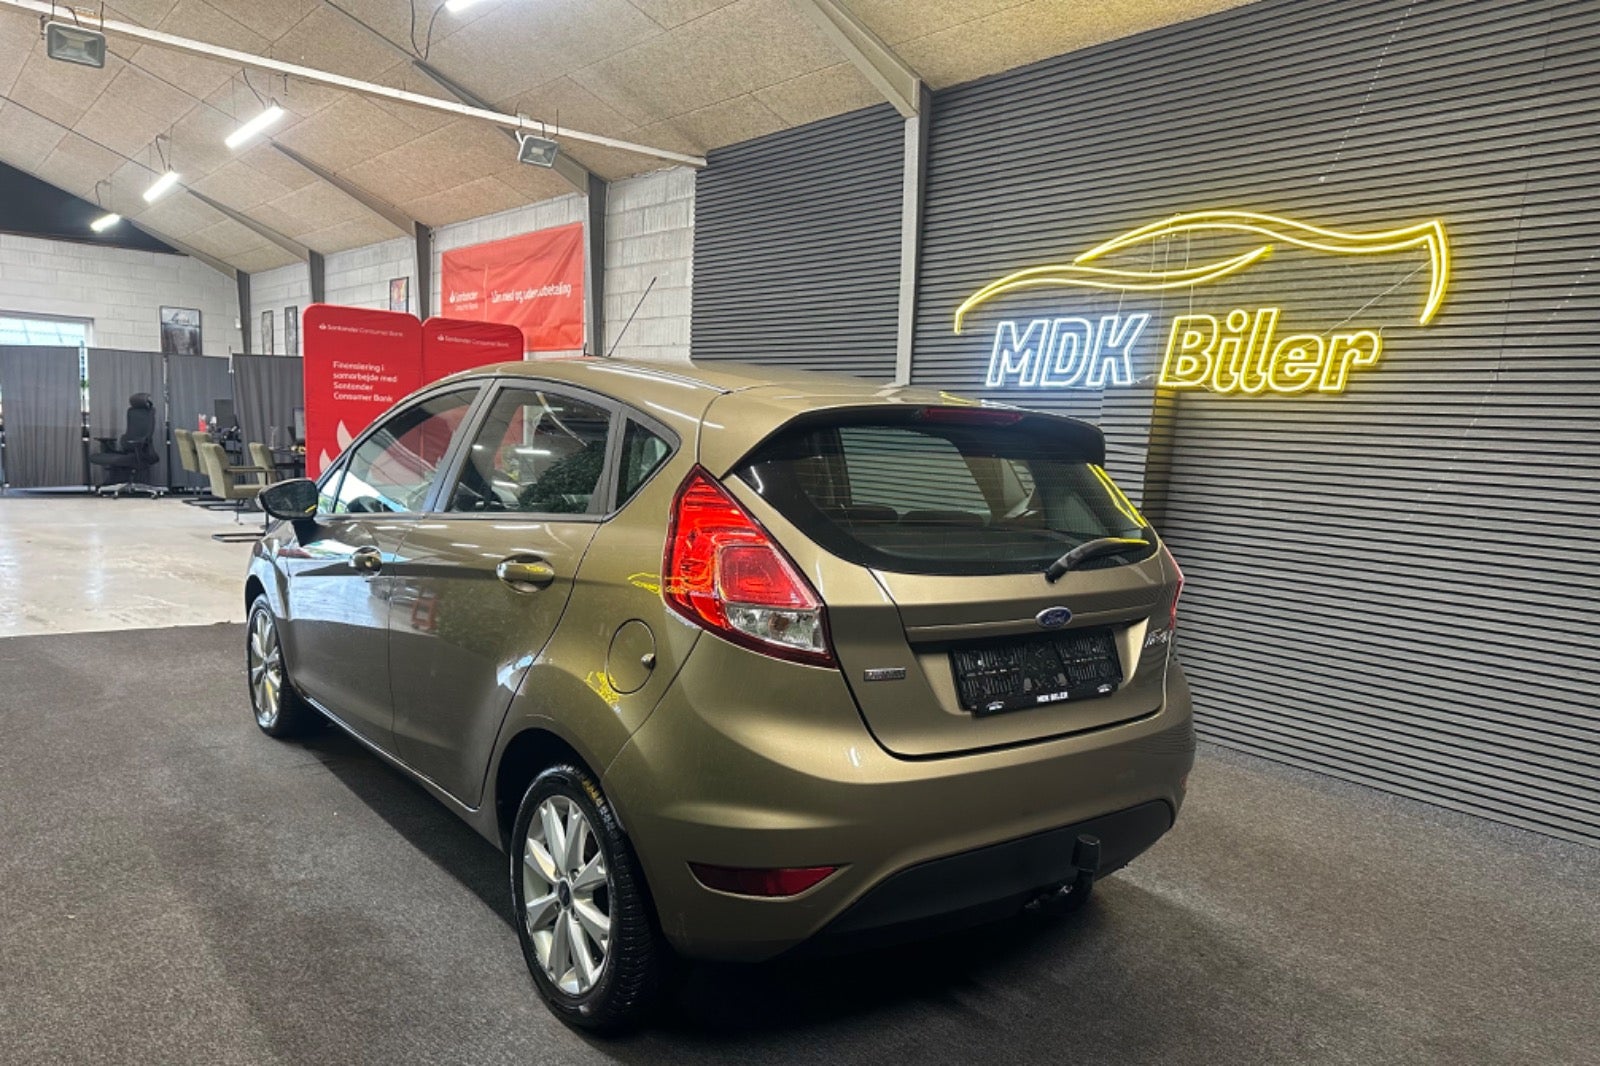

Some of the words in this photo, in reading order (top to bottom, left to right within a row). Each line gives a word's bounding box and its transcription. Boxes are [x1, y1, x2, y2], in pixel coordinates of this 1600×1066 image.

[985, 312, 1152, 389] MDK
[1158, 306, 1383, 393] Biler
[332, 360, 381, 373] Finansiering
[332, 373, 379, 383] samarbejde
[380, 375, 398, 383] med
[332, 381, 374, 391] Santander
[333, 391, 373, 401] Consumer
[373, 394, 394, 402] Bank
